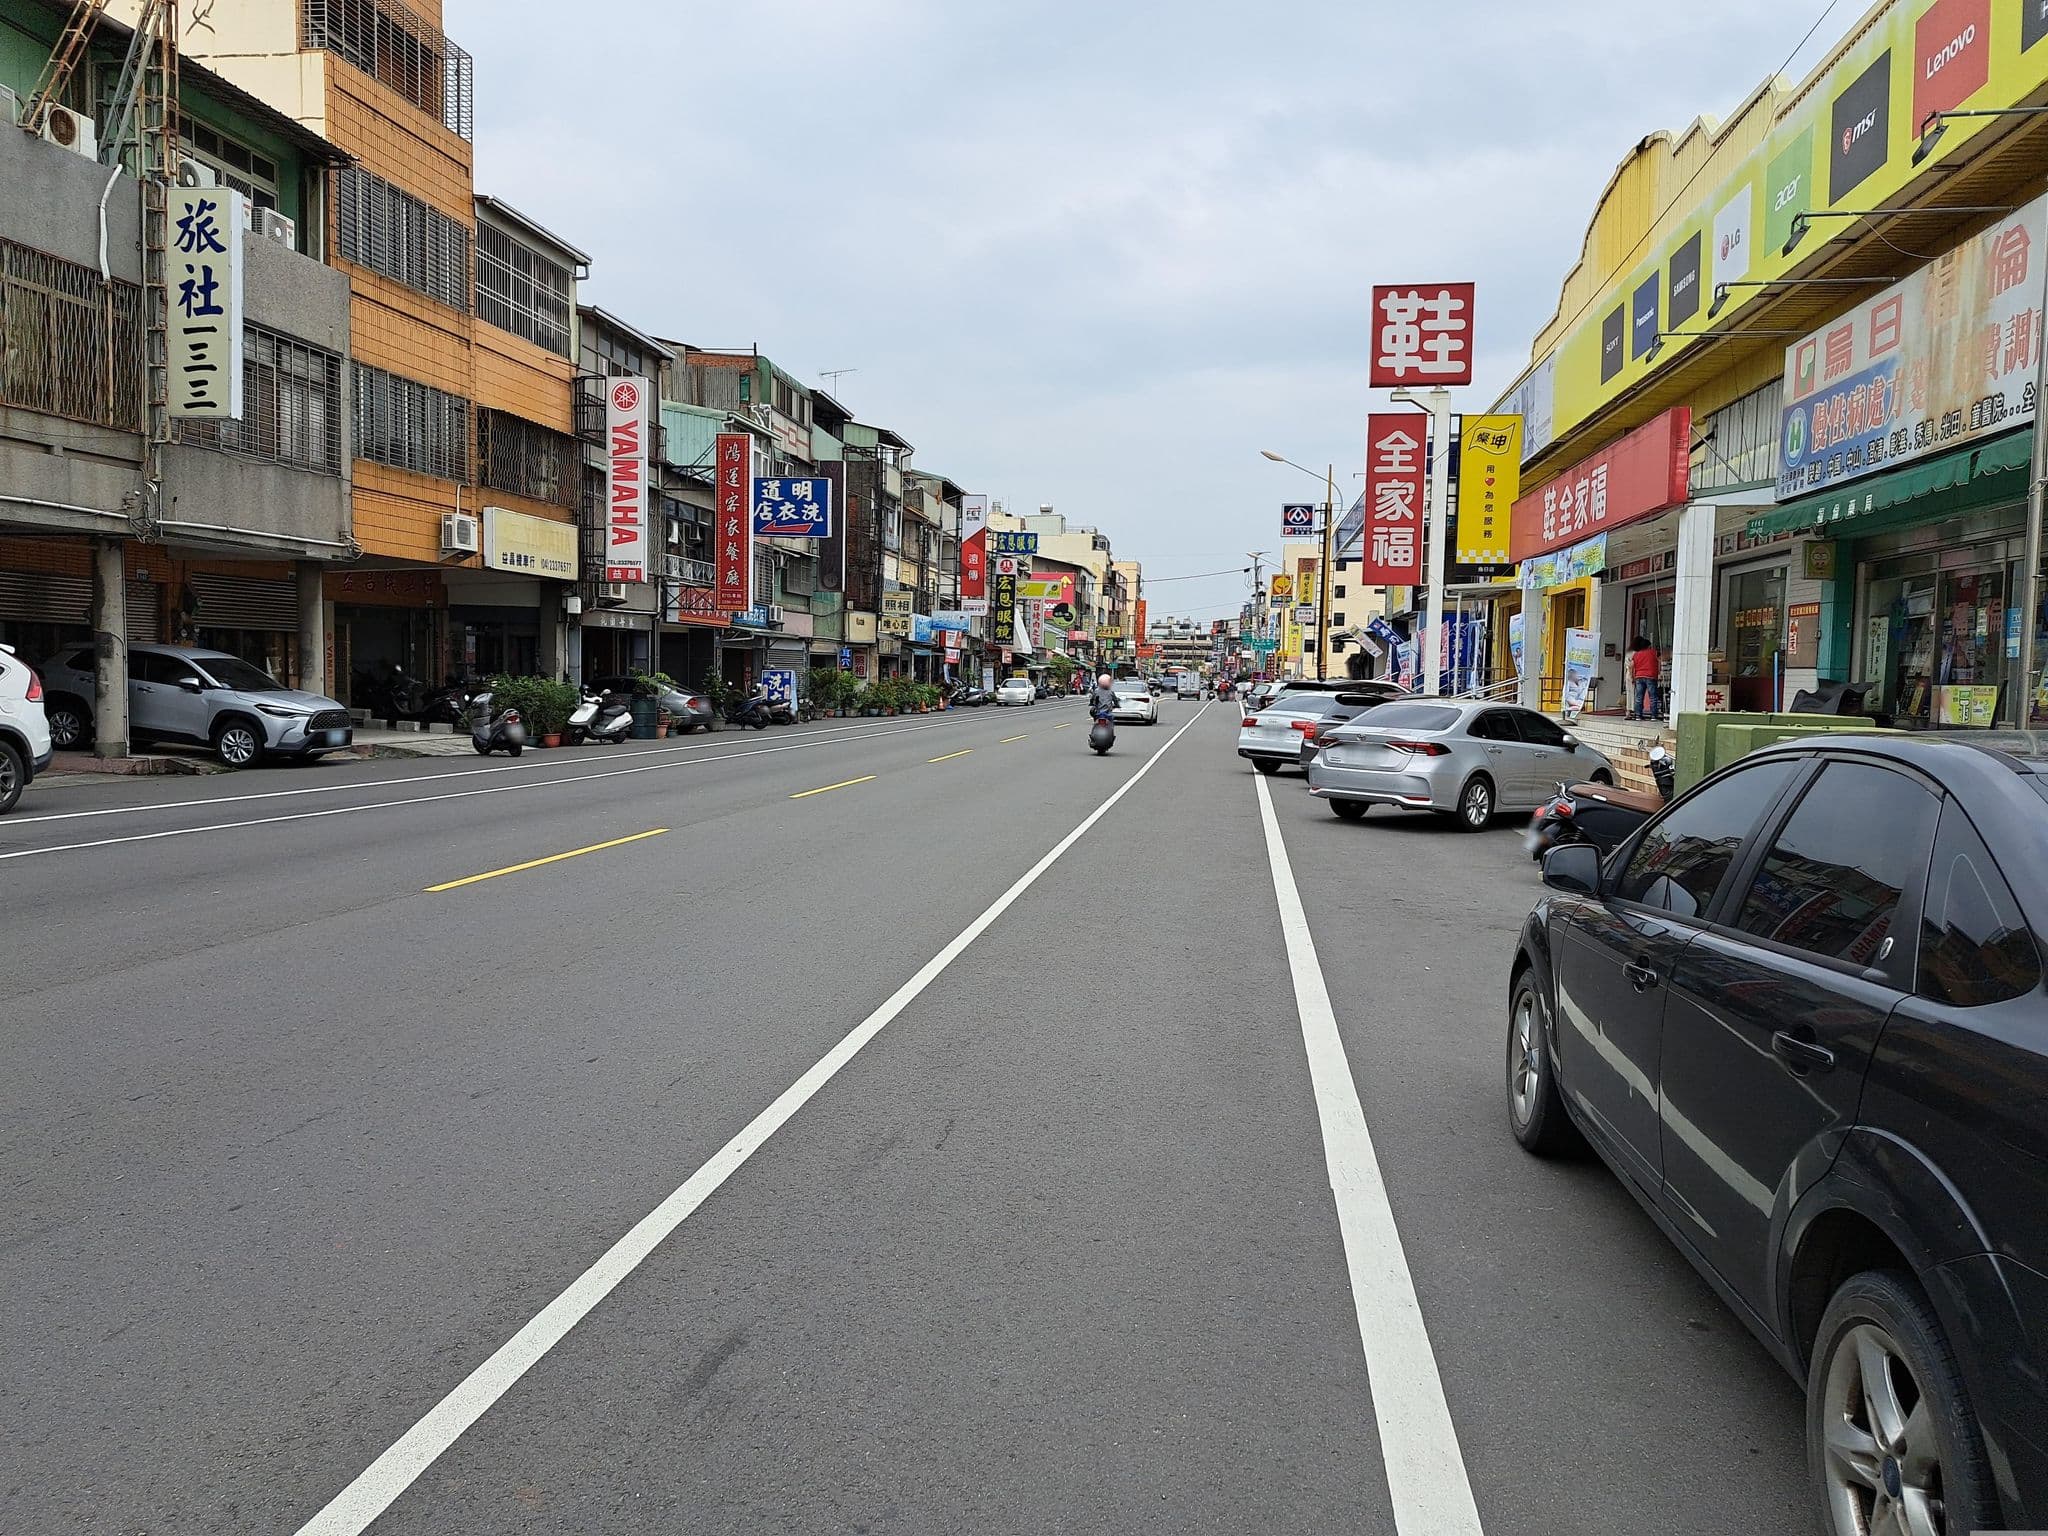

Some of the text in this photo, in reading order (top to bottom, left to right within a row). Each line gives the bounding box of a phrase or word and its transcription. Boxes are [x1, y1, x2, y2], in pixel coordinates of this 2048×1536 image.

[1926, 23, 1976, 80] Lenovo
[1852, 107, 1877, 144] msi
[1775, 175, 1800, 212] acer
[1731, 228, 1741, 250] LG
[1673, 269, 1696, 297] SAMSUNG
[1378, 290, 1466, 377] 鞋
[1636, 307, 1655, 328] Panasonic
[1605, 335, 1620, 354] SONY
[1475, 432, 1507, 449] 燦坤
[611, 419, 639, 546] YAMAHA
[761, 480, 813, 501] 明道
[1372, 430, 1419, 568] 全家福
[725, 442, 741, 586] 鴻運客家餐廳
[754, 502, 824, 522] 洗衣店
[1542, 462, 1608, 543] 鞋全家福
[967, 553, 979, 582] 遠傳
[885, 600, 909, 611] 照相
[994, 575, 1014, 640] 宏恩眼鏡
